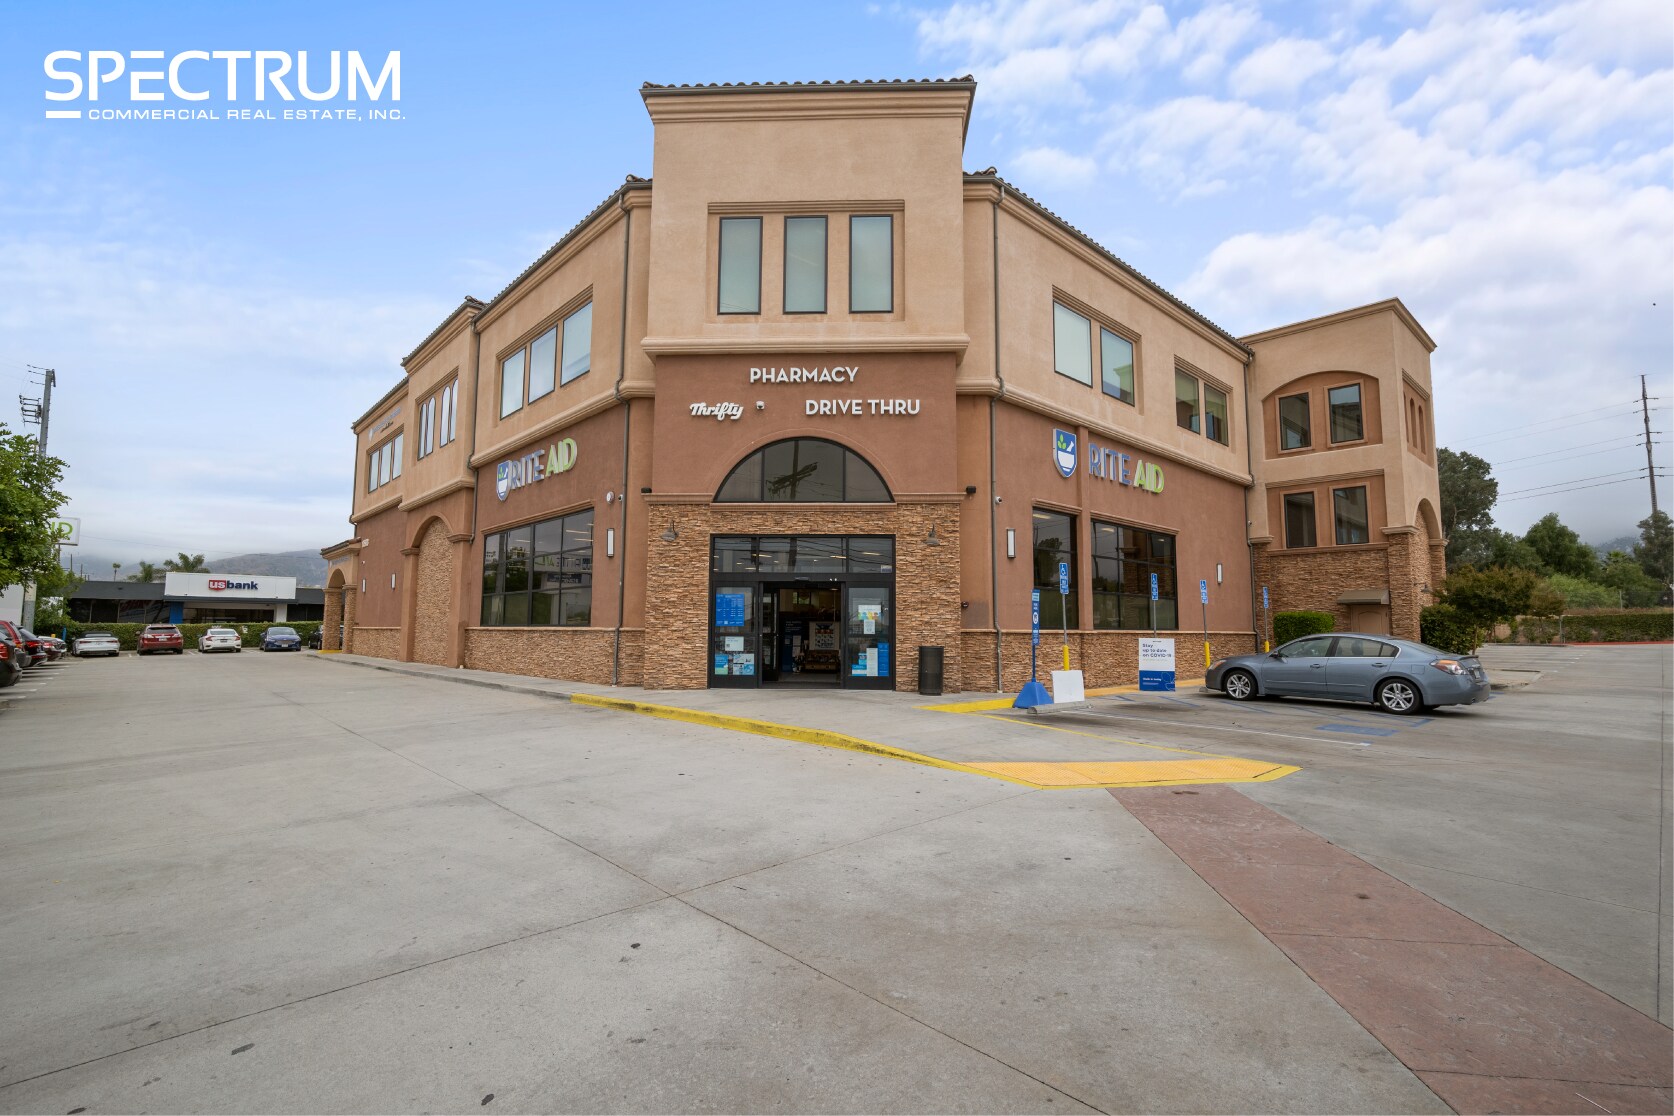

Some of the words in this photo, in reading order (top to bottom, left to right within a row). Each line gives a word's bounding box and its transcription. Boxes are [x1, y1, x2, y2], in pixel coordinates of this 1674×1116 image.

[750, 366, 859, 383] PHARMACY
[690, 402, 744, 420] Thrifty
[805, 399, 863, 416] DRIVE
[867, 399, 921, 416] THRU
[510, 449, 545, 490] RITE
[545, 438, 577, 477] AID
[1088, 442, 1132, 486] RITE
[1133, 459, 1165, 494] AID
